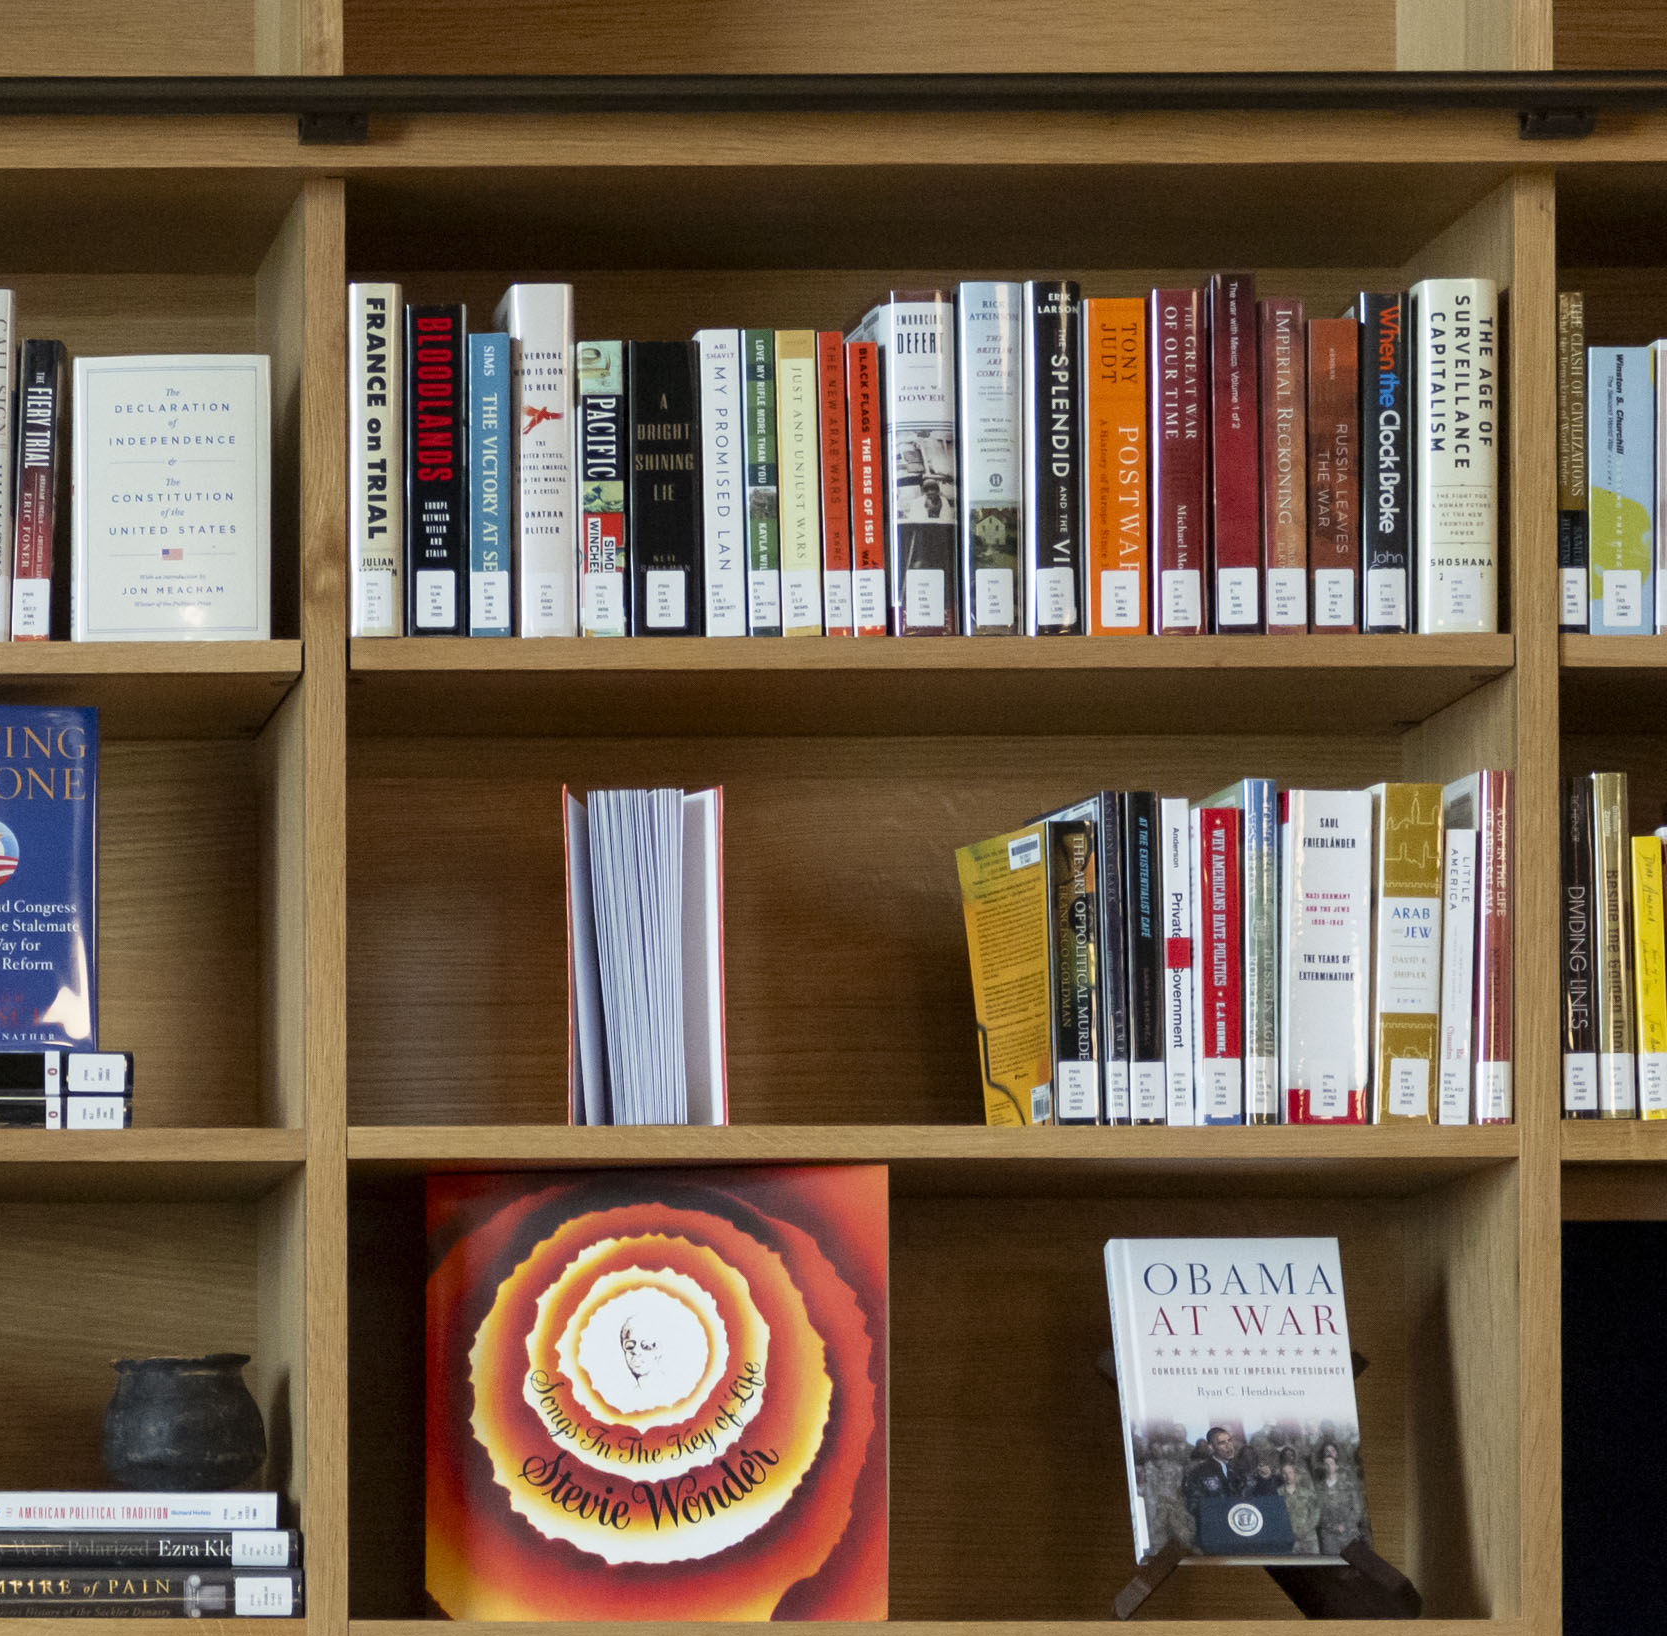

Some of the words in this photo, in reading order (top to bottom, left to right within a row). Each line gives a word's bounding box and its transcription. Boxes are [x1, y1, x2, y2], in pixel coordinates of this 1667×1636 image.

[366, 298, 387, 407] FRANCE
[1430, 312, 1444, 453] CAPITALISM
[1453, 295, 1470, 469] SURVEILLANCE
[417, 317, 452, 482] BLOODLANDS
[109, 435, 237, 446] INDEPENDENCE
[368, 418, 381, 450] on
[586, 397, 616, 478] PACIFIC
[112, 493, 234, 503] CONSTITUTION
[369, 458, 387, 539] TRIAL
[109, 525, 167, 536] UNITED
[177, 524, 237, 535] STATES
[123, 585, 150, 595] JON
[155, 585, 225, 595] MEACHAM
[1212, 829, 1225, 853] WHY
[1212, 855, 1225, 910] AMERICANS
[1213, 914, 1225, 939] HATE
[1392, 907, 1430, 919] ARAB
[1404, 927, 1431, 938] JEW
[2, 957, 53, 970] Reform
[1214, 942, 1226, 986] POLITICS
[1143, 1263, 1337, 1295] OBAMA
[1148, 1306, 1208, 1336] AT
[1233, 1305, 1341, 1335] WAR
[518, 1455, 630, 1530] Stevie
[632, 1447, 779, 1531] Wonder
[19, 1506, 65, 1519] AMERICAN
[70, 1507, 116, 1519] POLITICAL
[121, 1507, 168, 1519] TRADITION
[84, 1580, 98, 1595] of
[108, 1580, 170, 1594] PAIN
